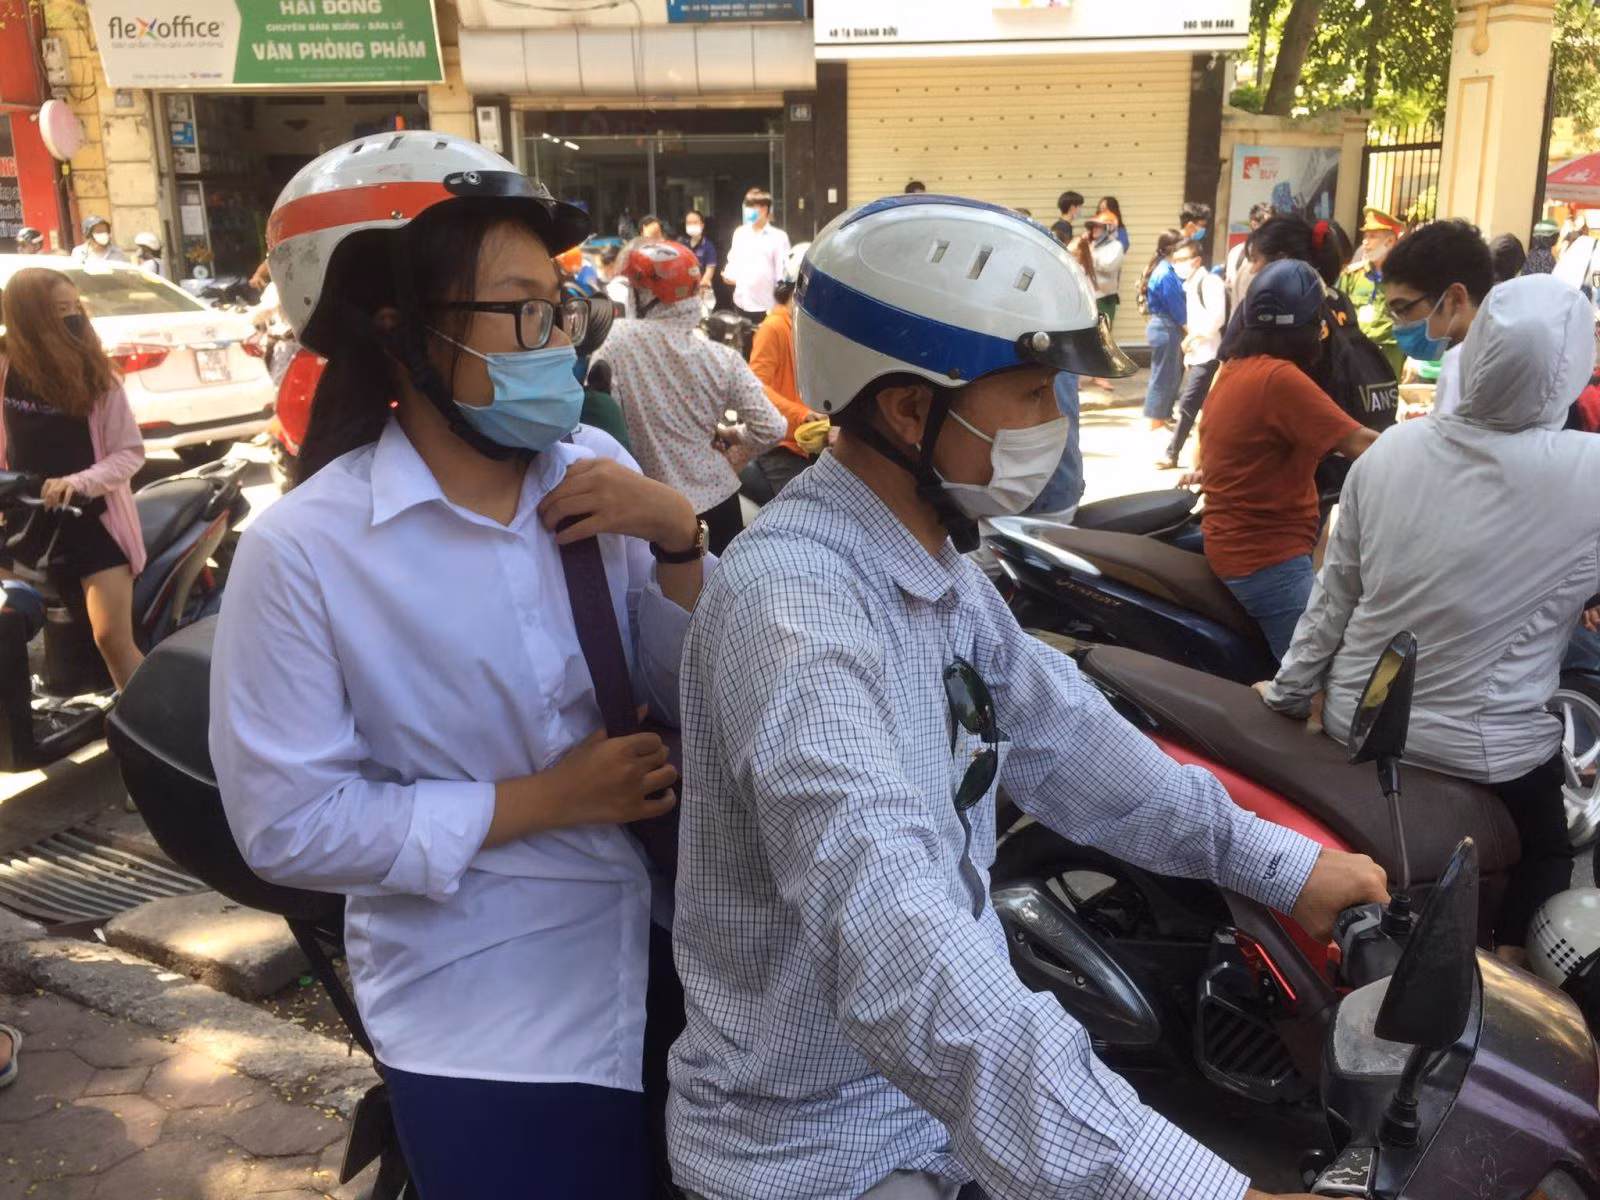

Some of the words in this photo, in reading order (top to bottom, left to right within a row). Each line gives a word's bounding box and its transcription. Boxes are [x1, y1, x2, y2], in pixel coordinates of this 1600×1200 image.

[109, 15, 220, 40] flexoffice
[251, 40, 294, 61] VĂN
[297, 38, 365, 60] PHÒNG
[1358, 382, 1398, 413] VANS
